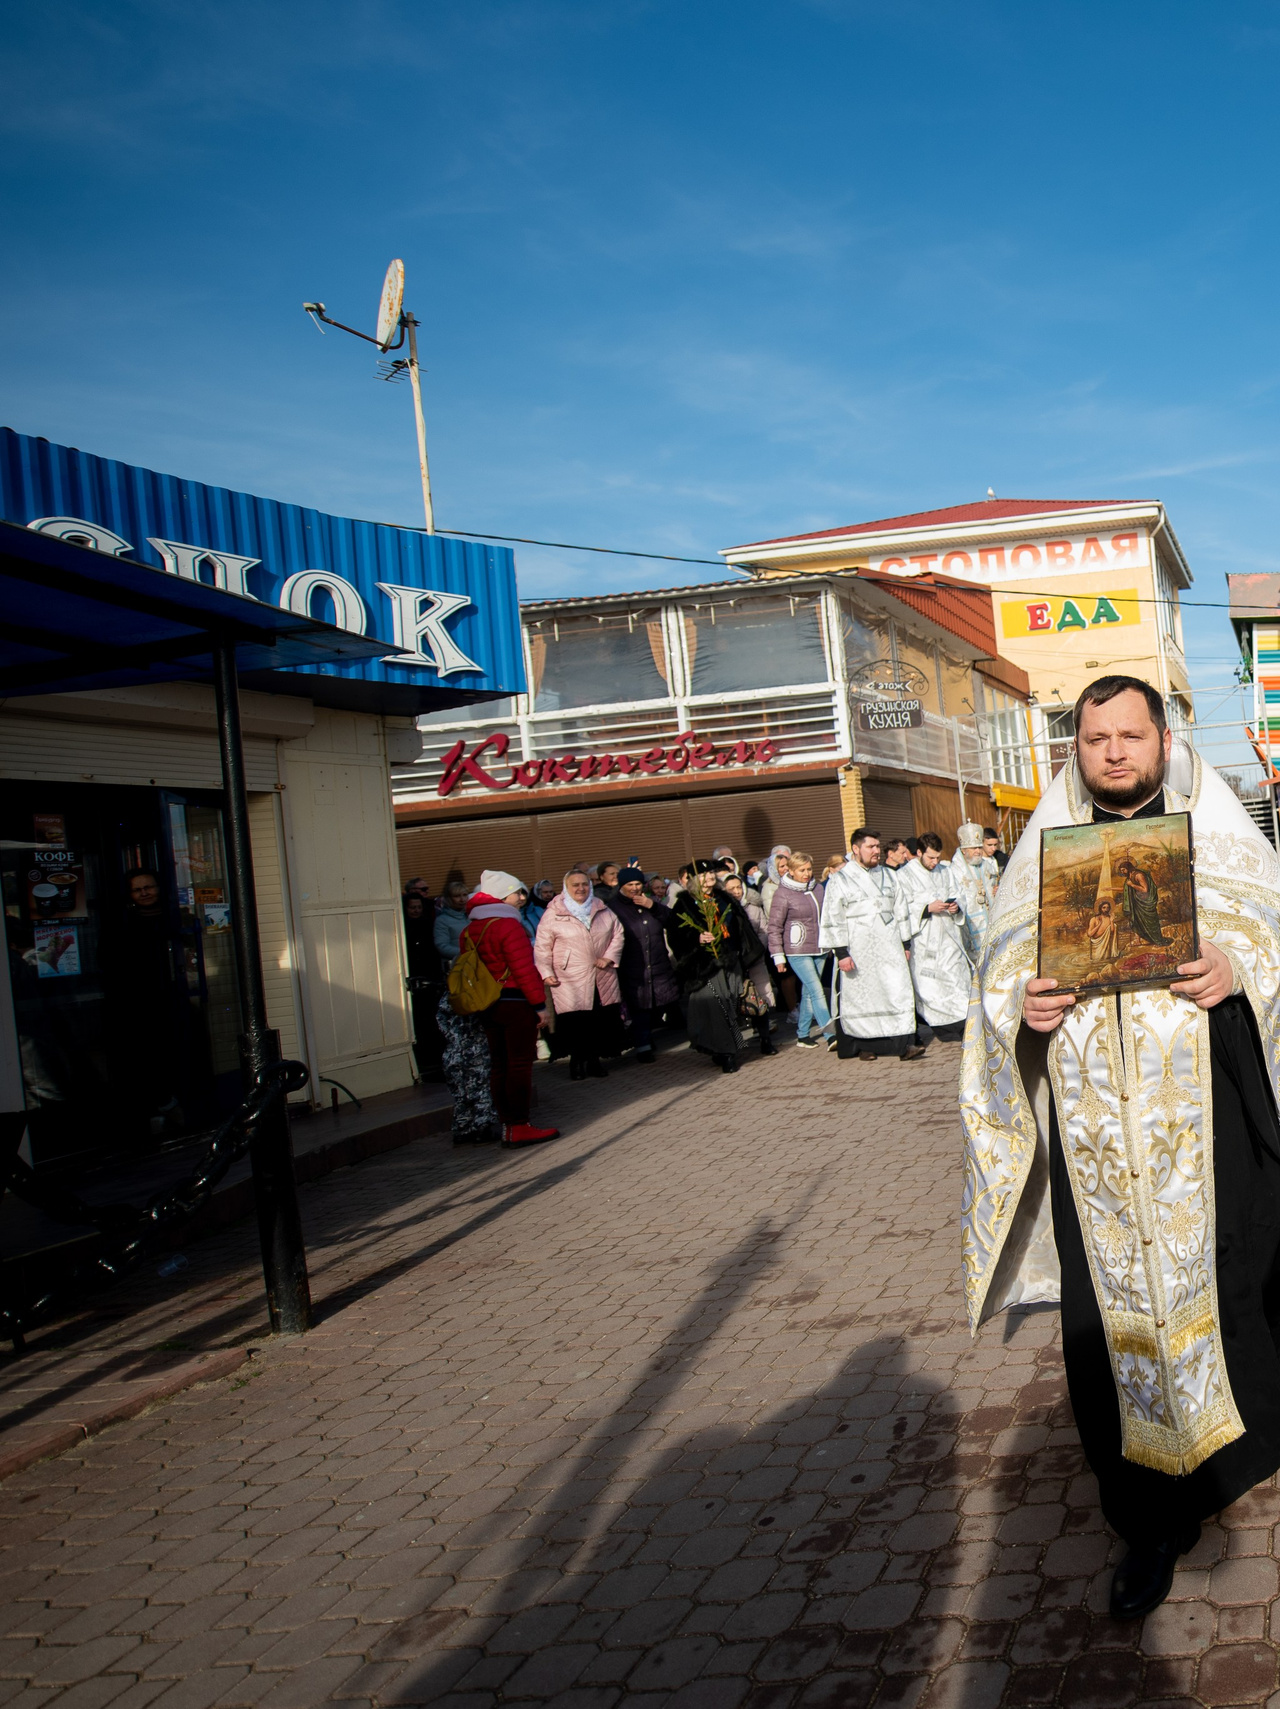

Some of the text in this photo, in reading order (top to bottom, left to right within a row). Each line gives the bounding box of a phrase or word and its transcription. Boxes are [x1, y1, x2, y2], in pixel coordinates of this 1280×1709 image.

[1026, 597, 1120, 632] ЕДА
[868, 711, 912, 729] КУХНЯ
[437, 730, 781, 797] Коктебель
[34, 851, 76, 862] КОФЕ
